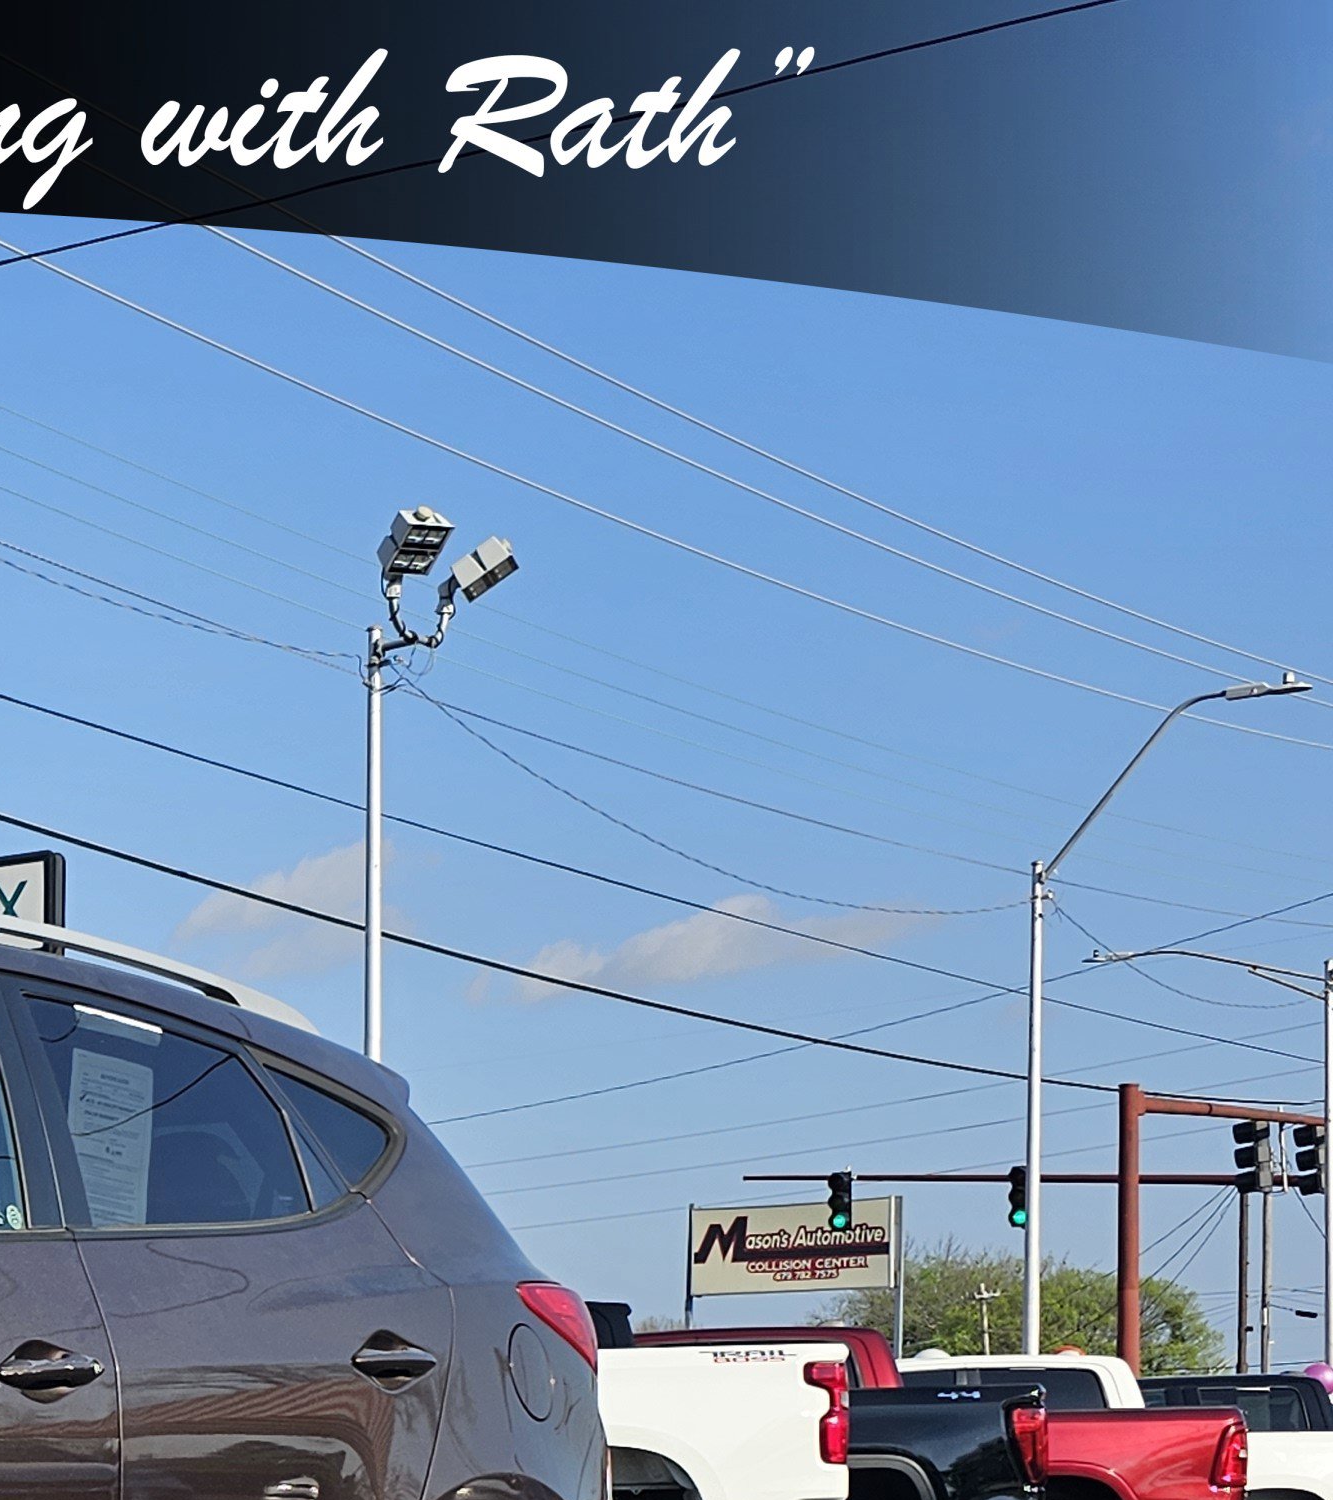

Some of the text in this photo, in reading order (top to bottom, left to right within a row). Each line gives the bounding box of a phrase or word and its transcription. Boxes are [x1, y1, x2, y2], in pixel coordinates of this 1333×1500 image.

[694, 1215, 885, 1264] Mason's Automotive
[747, 1256, 867, 1273] COLLISION CENTER
